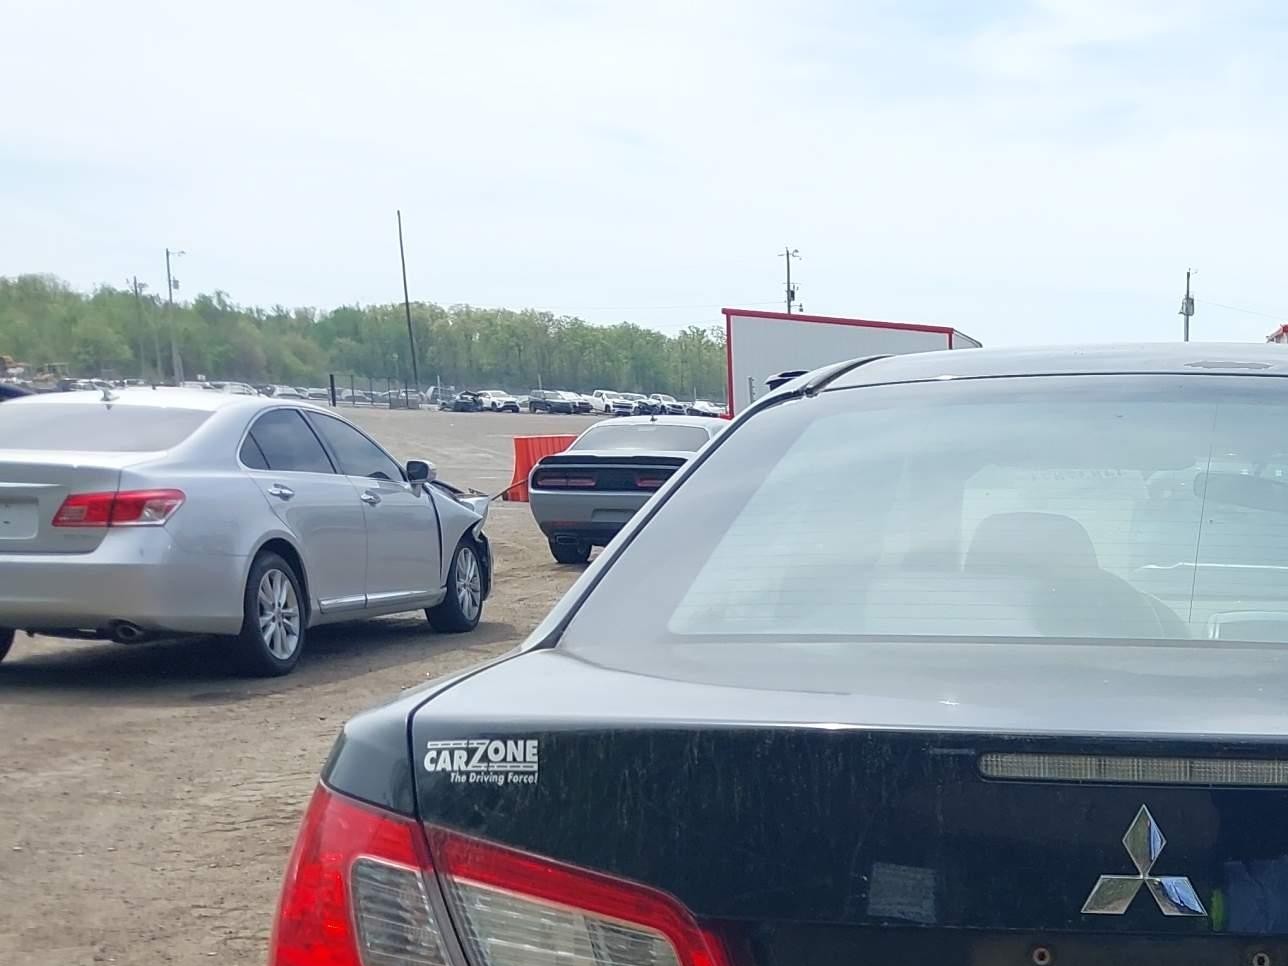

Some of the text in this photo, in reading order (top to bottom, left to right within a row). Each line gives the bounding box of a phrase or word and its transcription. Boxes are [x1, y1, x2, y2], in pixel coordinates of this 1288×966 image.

[450, 772, 538, 786] The Driving Force!
